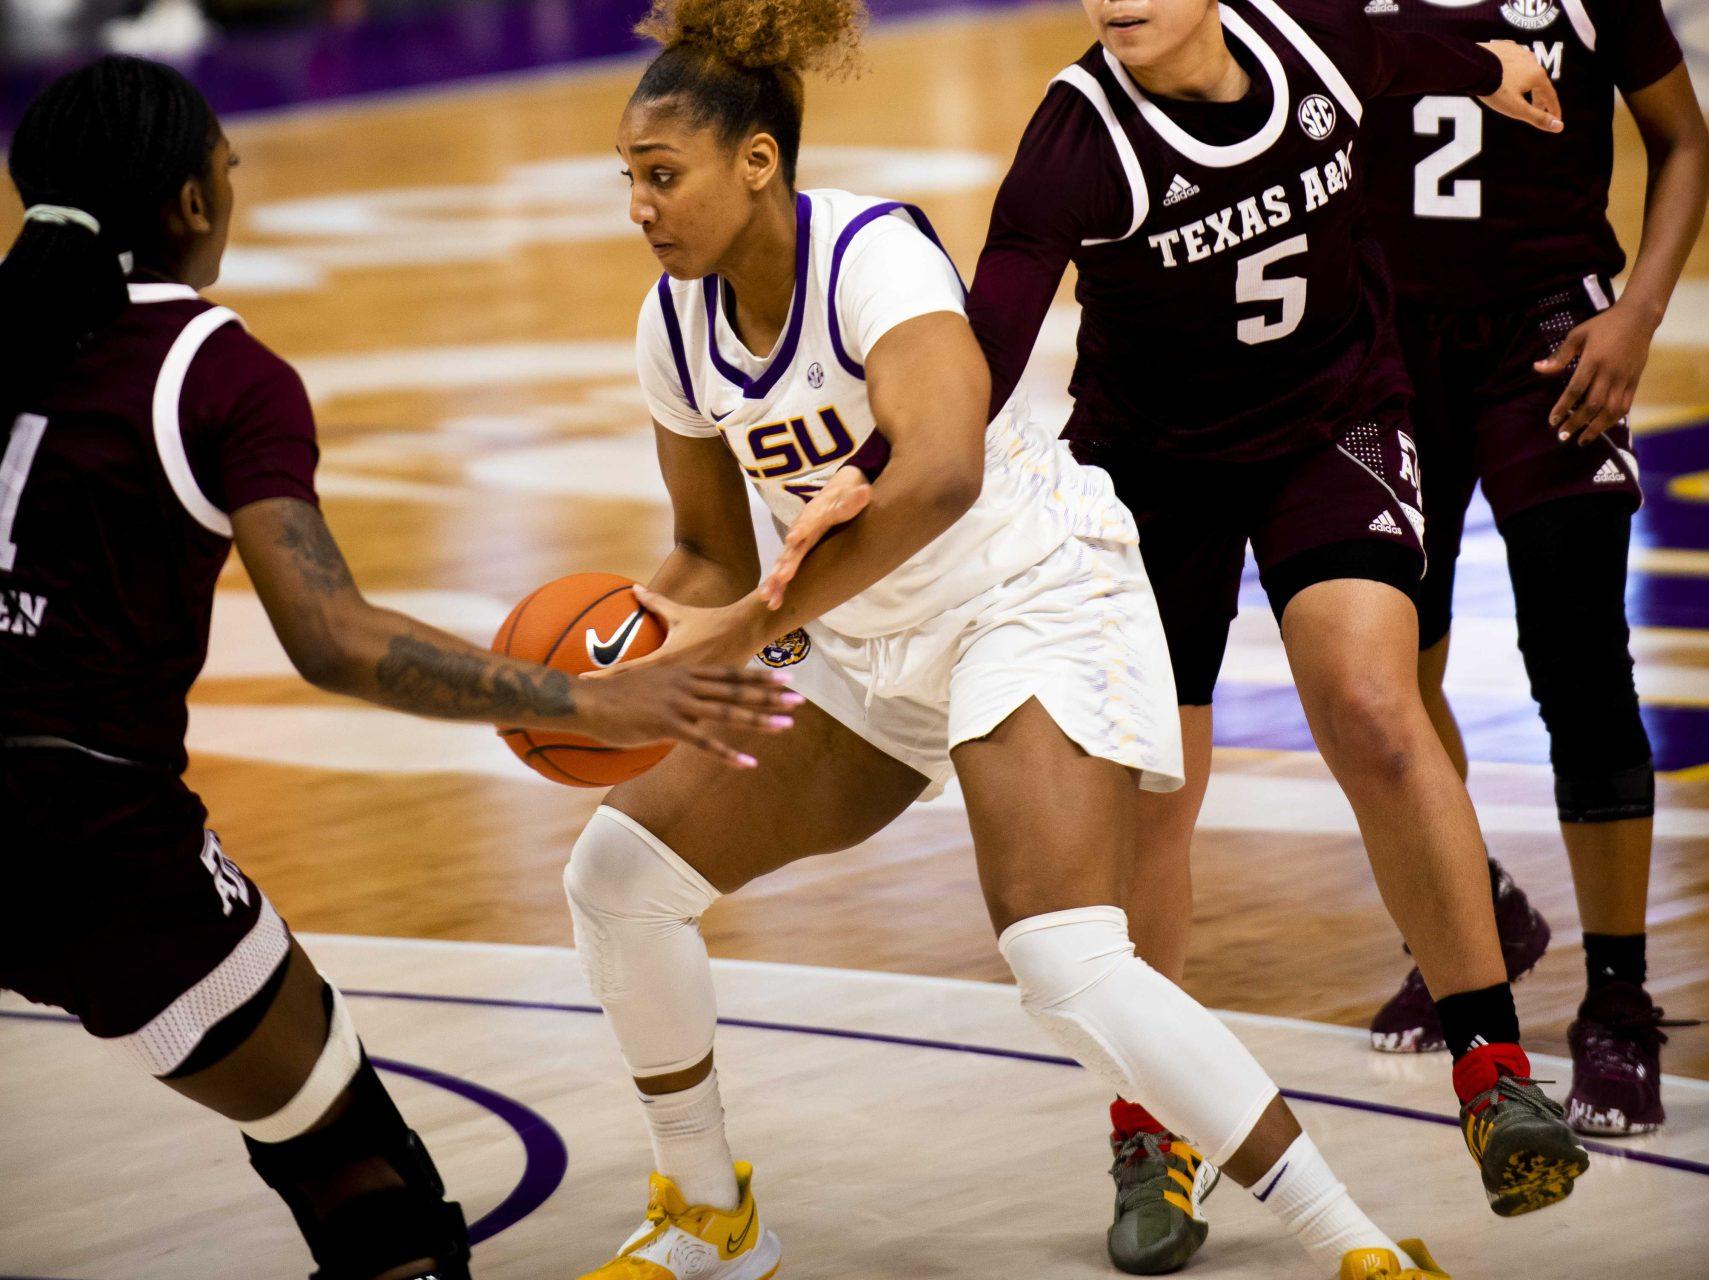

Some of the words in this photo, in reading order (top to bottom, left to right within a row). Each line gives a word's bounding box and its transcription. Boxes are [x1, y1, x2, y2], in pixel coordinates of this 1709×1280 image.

[1364, 3, 1399, 14] adidas
[1301, 96, 1333, 137] SEC
[1413, 96, 1483, 219] 2
[1148, 185, 1291, 268] TEXAS
[1300, 140, 1353, 213] A&M
[1163, 184, 1200, 206] adidas
[1236, 233, 1309, 345] 5
[1593, 472, 1626, 482] adidas
[1369, 523, 1402, 536] adidas
